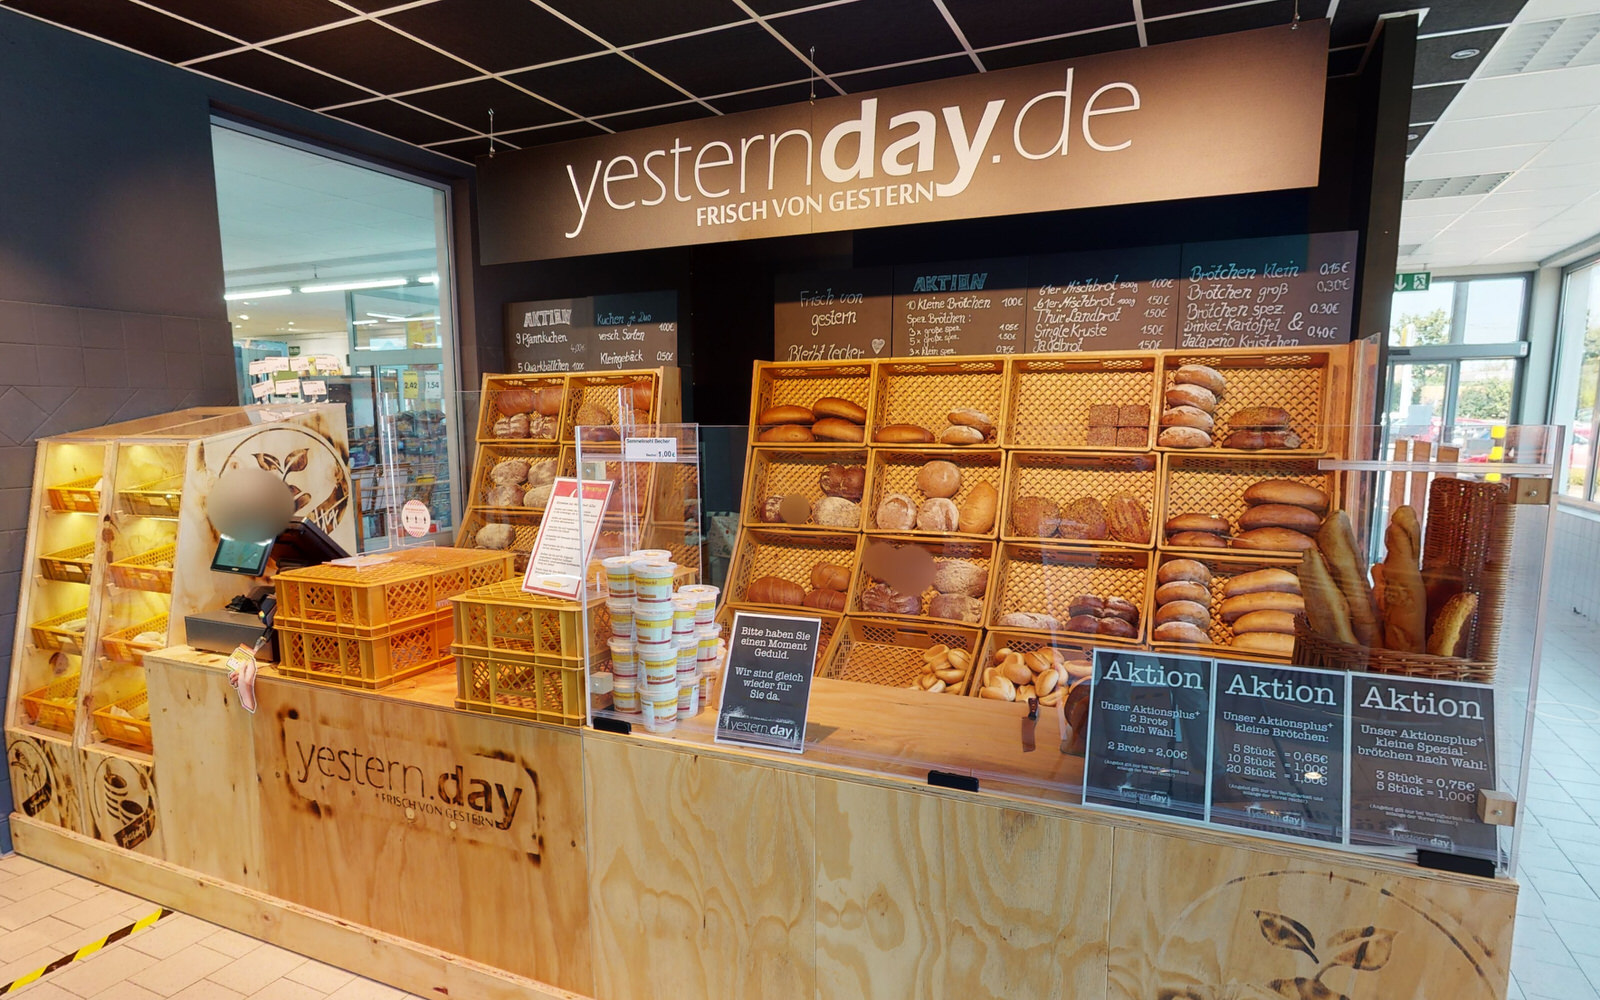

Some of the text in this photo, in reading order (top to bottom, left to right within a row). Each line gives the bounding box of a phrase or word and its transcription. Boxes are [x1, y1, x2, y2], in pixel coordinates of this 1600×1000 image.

[564, 67, 1141, 239] yesternday.de
[696, 181, 935, 227] FRISCH VON GESTERN
[1189, 263, 1257, 283] Brötchen
[1263, 260, 1300, 279] klein
[1120, 282, 1138, 293] 500g
[1186, 284, 1252, 301] Brötchen
[1257, 283, 1289, 303] groß
[800, 288, 864, 308] Frisch von
[947, 295, 991, 310] Brötchen
[597, 312, 624, 326] Kuchen
[928, 312, 966, 324] Brötchen
[1065, 307, 1122, 323] Landbrot
[1186, 302, 1249, 320] Brötchen
[811, 309, 857, 336] gestern
[1034, 324, 1070, 338] Single
[1070, 323, 1108, 338] Kruste
[1287, 312, 1304, 331] &
[515, 331, 568, 348] 9 Pfannkuchen
[600, 349, 644, 369] Kleingebäck
[827, 344, 865, 361] lecker
[517, 362, 523, 372] 5
[741, 626, 811, 641] Bitte haben Sie
[741, 637, 808, 651] einen Moment
[754, 648, 789, 660] Geduld.
[735, 666, 804, 683] Wir sind gleich
[1103, 660, 1203, 690] Aktion
[743, 679, 792, 692] wieder für
[1225, 674, 1337, 706] Aktion
[749, 689, 780, 701] Sie da.
[1360, 686, 1485, 721] Aktion
[1101, 701, 1130, 712] Unser
[1129, 714, 1168, 726] 2 Brote
[1223, 711, 1256, 723] Unser
[730, 720, 793, 739] yestern.day
[1120, 724, 1145, 734] nach
[1235, 723, 1329, 743] kleine Brötchen:
[1360, 724, 1397, 737] Unser
[1107, 741, 1115, 750] 2
[1117, 742, 1145, 753] Brote
[1156, 748, 1188, 760] 2,00€
[1233, 743, 1241, 753] 5
[1243, 744, 1276, 757] Stück
[1293, 751, 1329, 764] 0,65€
[1375, 737, 1468, 757] kleine Spezial-
[1228, 753, 1241, 763] 10
[1243, 754, 1276, 768] Stück
[1294, 762, 1328, 775] 1,00€
[1357, 746, 1488, 771] brötchen nach Wahl:
[1226, 764, 1242, 773] 20
[1243, 766, 1277, 779] Stück
[296, 740, 523, 830] yestern.day
[1376, 770, 1384, 780] 3
[1387, 770, 1423, 785] Stück
[1436, 778, 1476, 793] 0,75€
[1376, 781, 1385, 791] 5
[1387, 782, 1424, 797] Stück
[1438, 789, 1476, 804] 1,00€
[381, 792, 495, 827] FRISCH VON GESTERN
